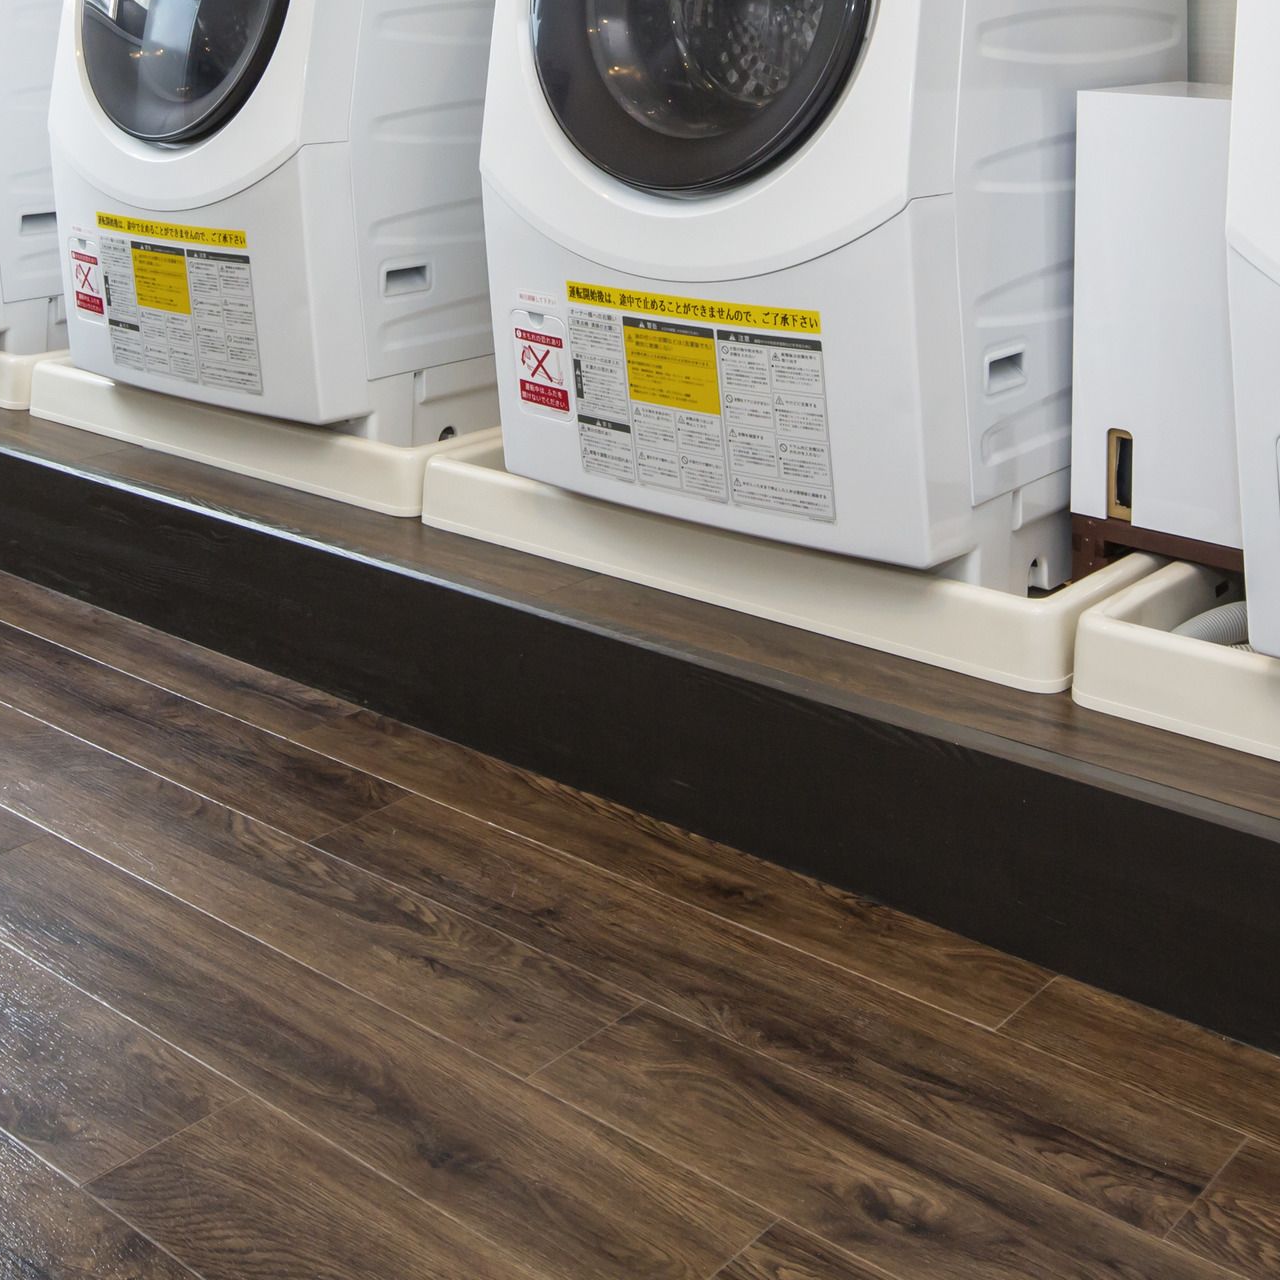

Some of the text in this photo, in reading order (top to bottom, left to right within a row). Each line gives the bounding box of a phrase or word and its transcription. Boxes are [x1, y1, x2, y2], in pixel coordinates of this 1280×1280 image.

[568, 286, 819, 330] 運転開始後は、途中で止めることができませんので、ご了承下さい
